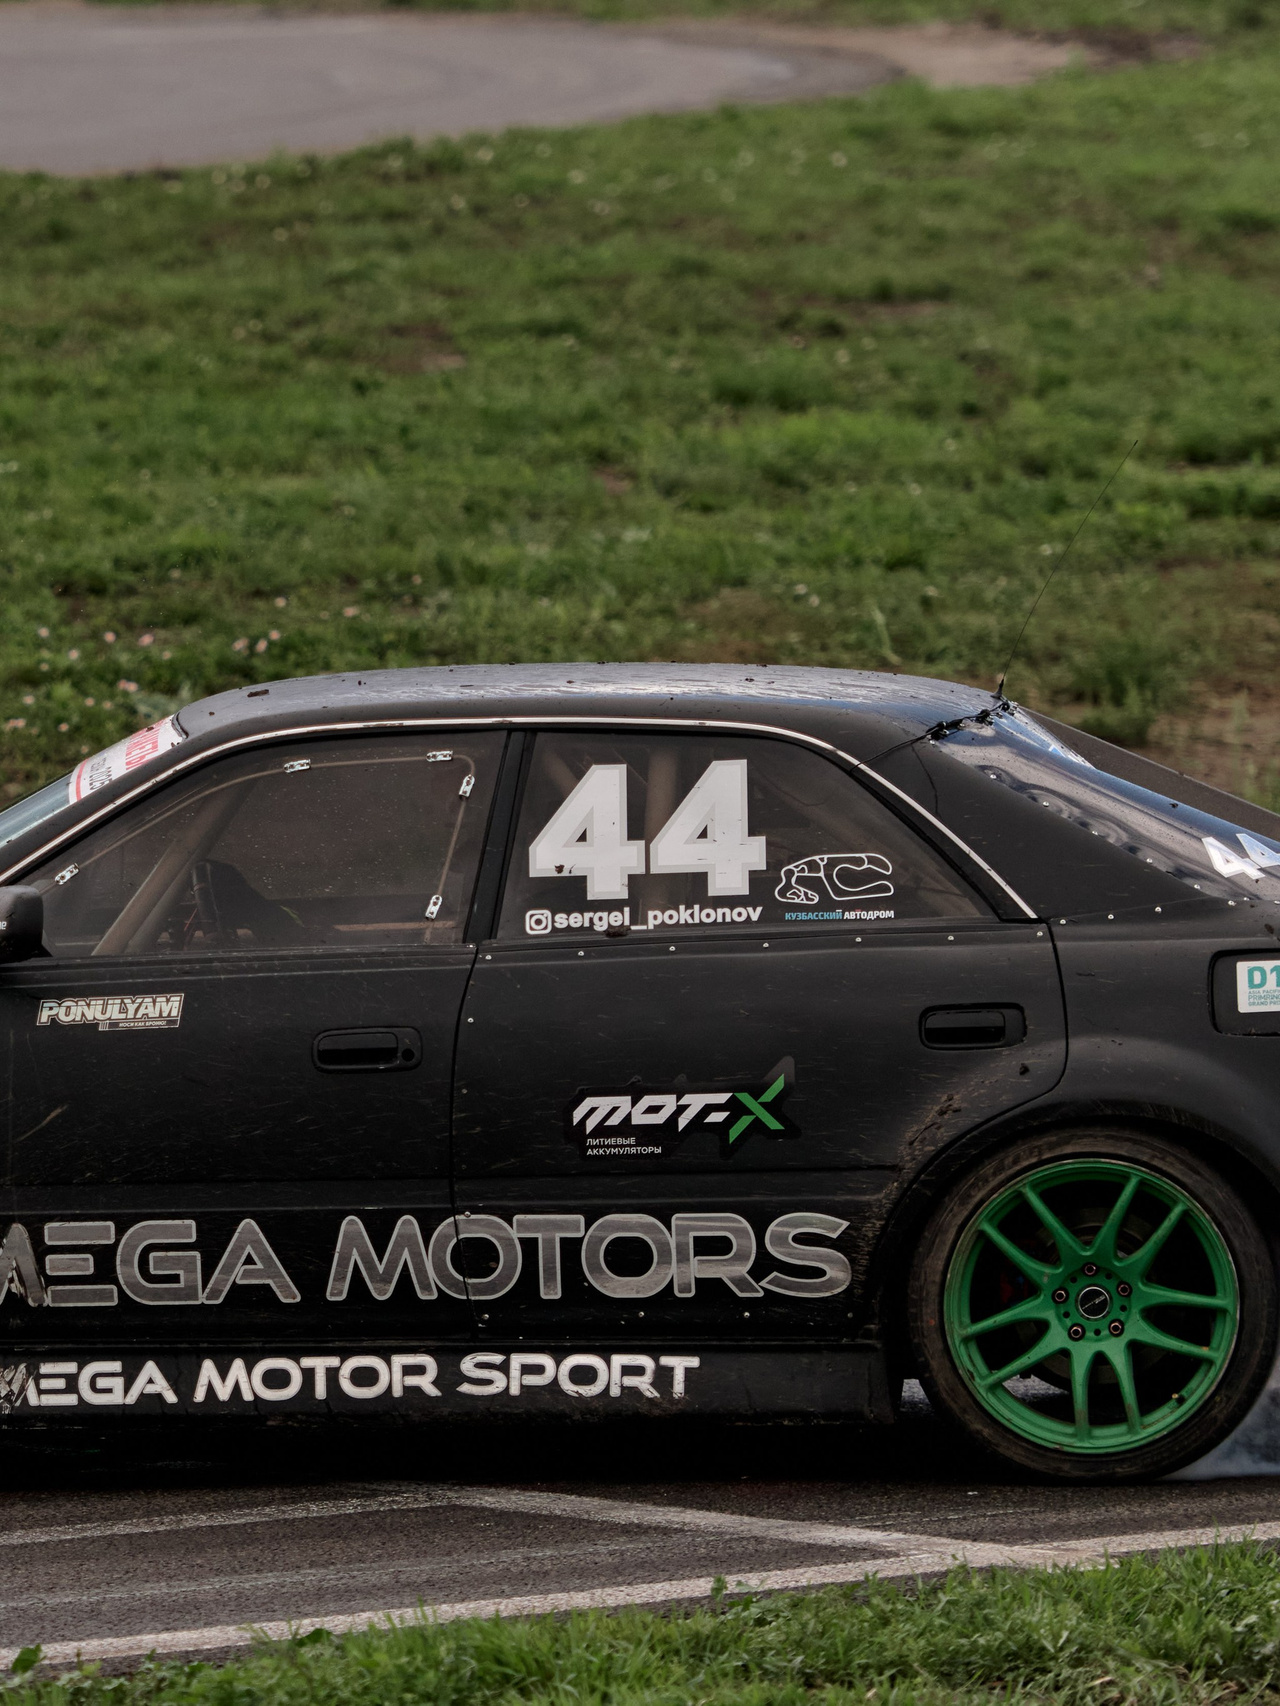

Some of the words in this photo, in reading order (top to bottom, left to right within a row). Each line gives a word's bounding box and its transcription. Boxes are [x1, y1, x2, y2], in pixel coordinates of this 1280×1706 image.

[529, 759, 766, 900] 44
[554, 904, 763, 932] sergei_poklonov
[785, 909, 842, 920] КУЗБАССКИЙ
[843, 910, 894, 920] АВТОДРОМ
[40, 996, 181, 1023] PONULYAM
[586, 1137, 636, 1146] ЛИТИЕВЫЕ
[586, 1146, 662, 1155] АККУМУЛЯТОРЫ
[325, 1212, 852, 1301] MOTORS
[193, 1354, 442, 1402] MOTOR
[456, 1352, 700, 1399] SPORT
